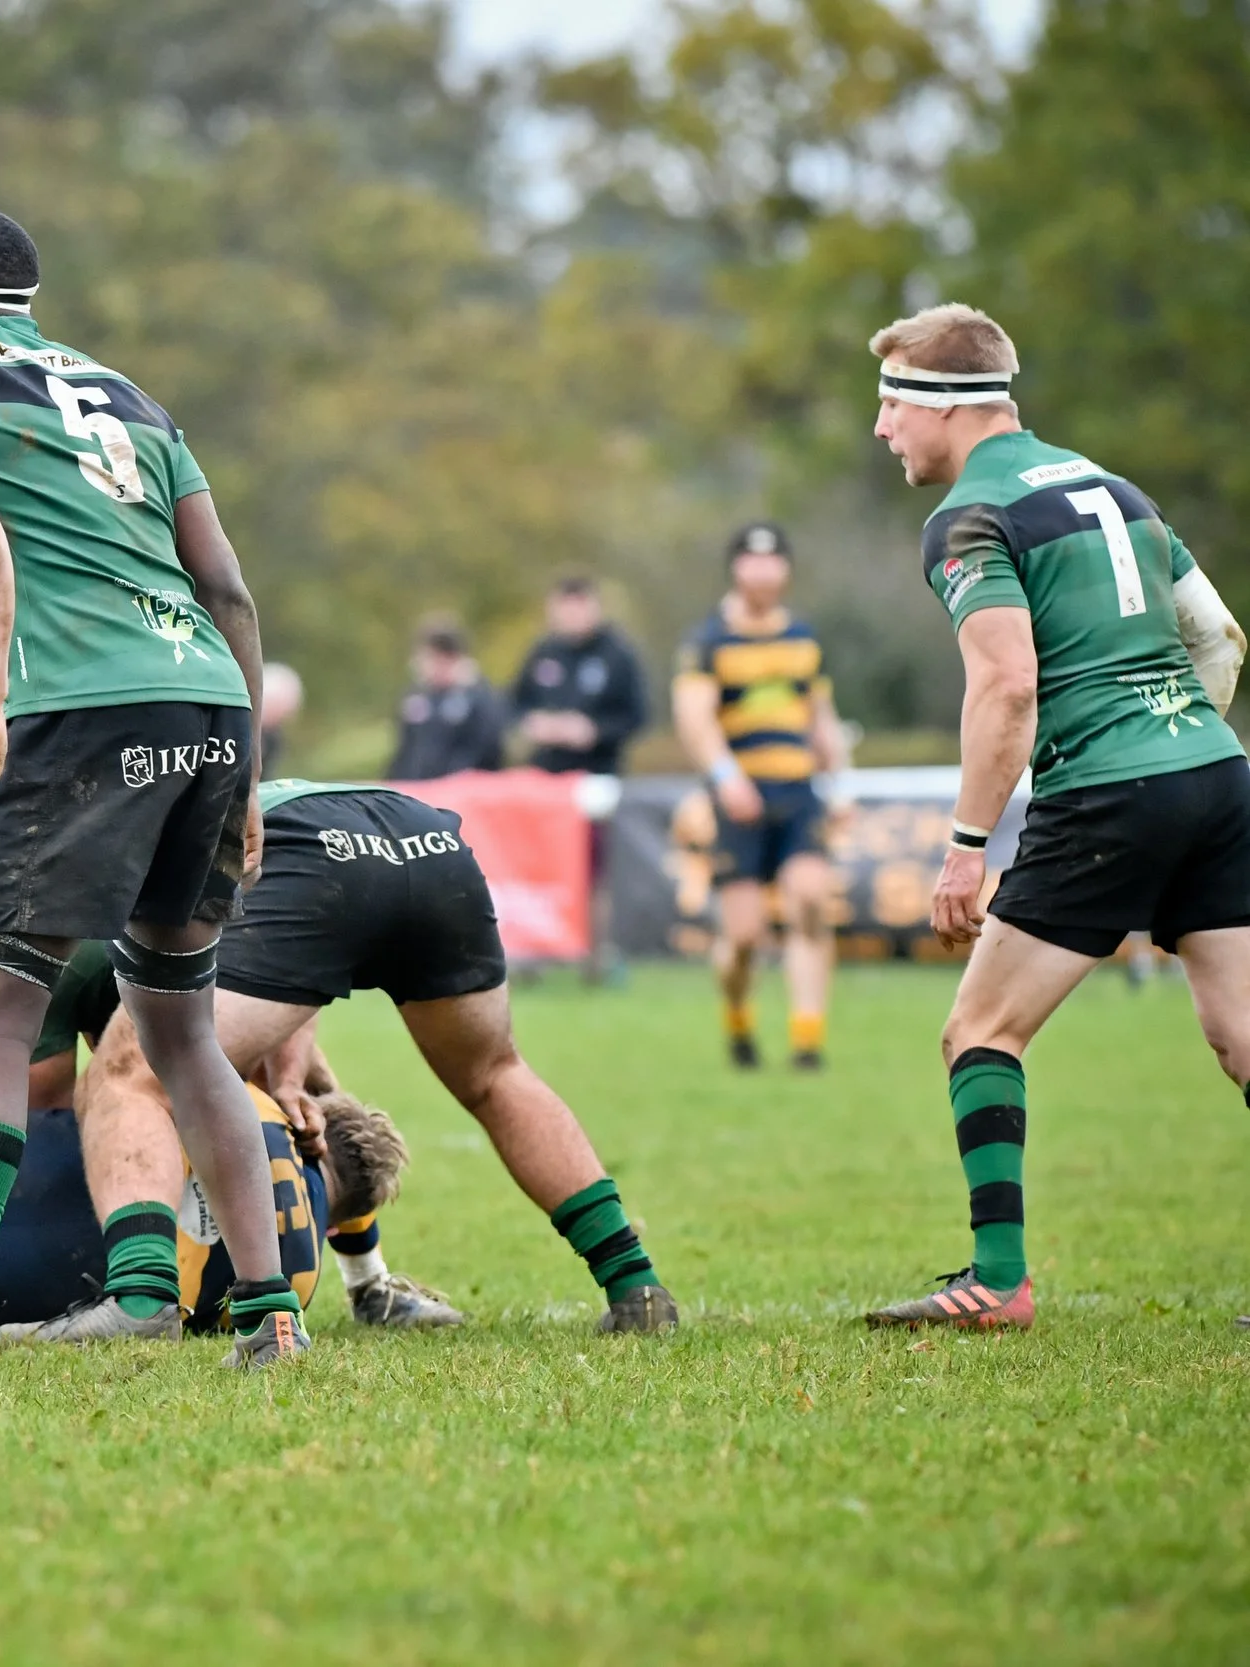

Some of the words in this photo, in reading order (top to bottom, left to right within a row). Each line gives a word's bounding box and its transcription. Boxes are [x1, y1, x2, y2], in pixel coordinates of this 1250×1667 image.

[45, 374, 146, 504] 5
[134, 593, 199, 630] IPA
[1064, 485, 1147, 618] 7
